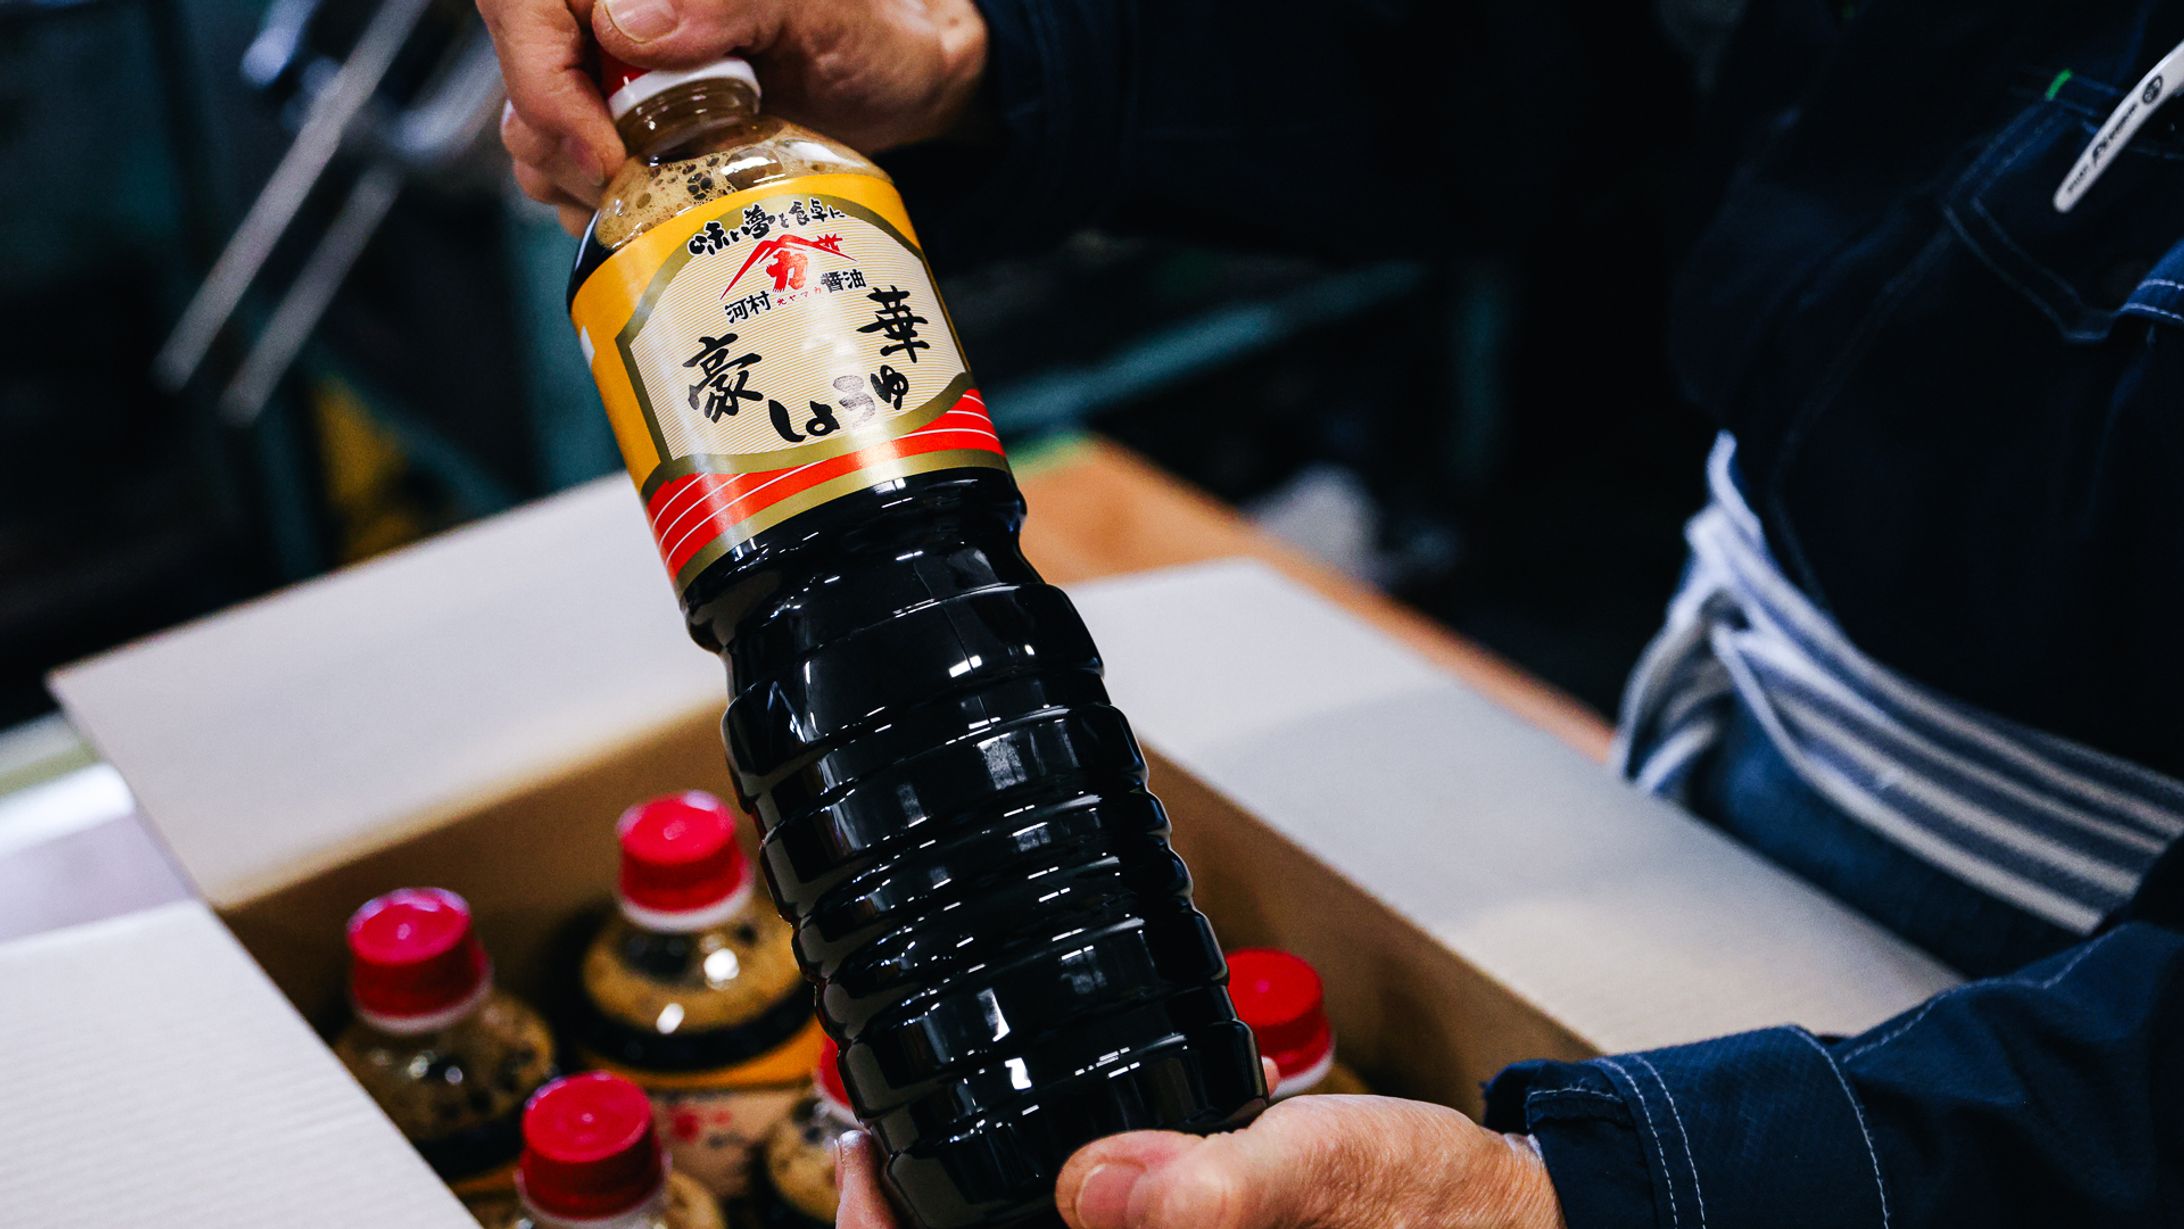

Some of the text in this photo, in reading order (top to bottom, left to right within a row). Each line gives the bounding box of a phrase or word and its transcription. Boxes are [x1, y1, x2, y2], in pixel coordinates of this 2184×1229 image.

[688, 198, 846, 256] 味と夢を食卓に
[724, 290, 771, 324] 河村
[682, 286, 931, 424] 豪 華
[767, 364, 910, 443] しょうゆ
